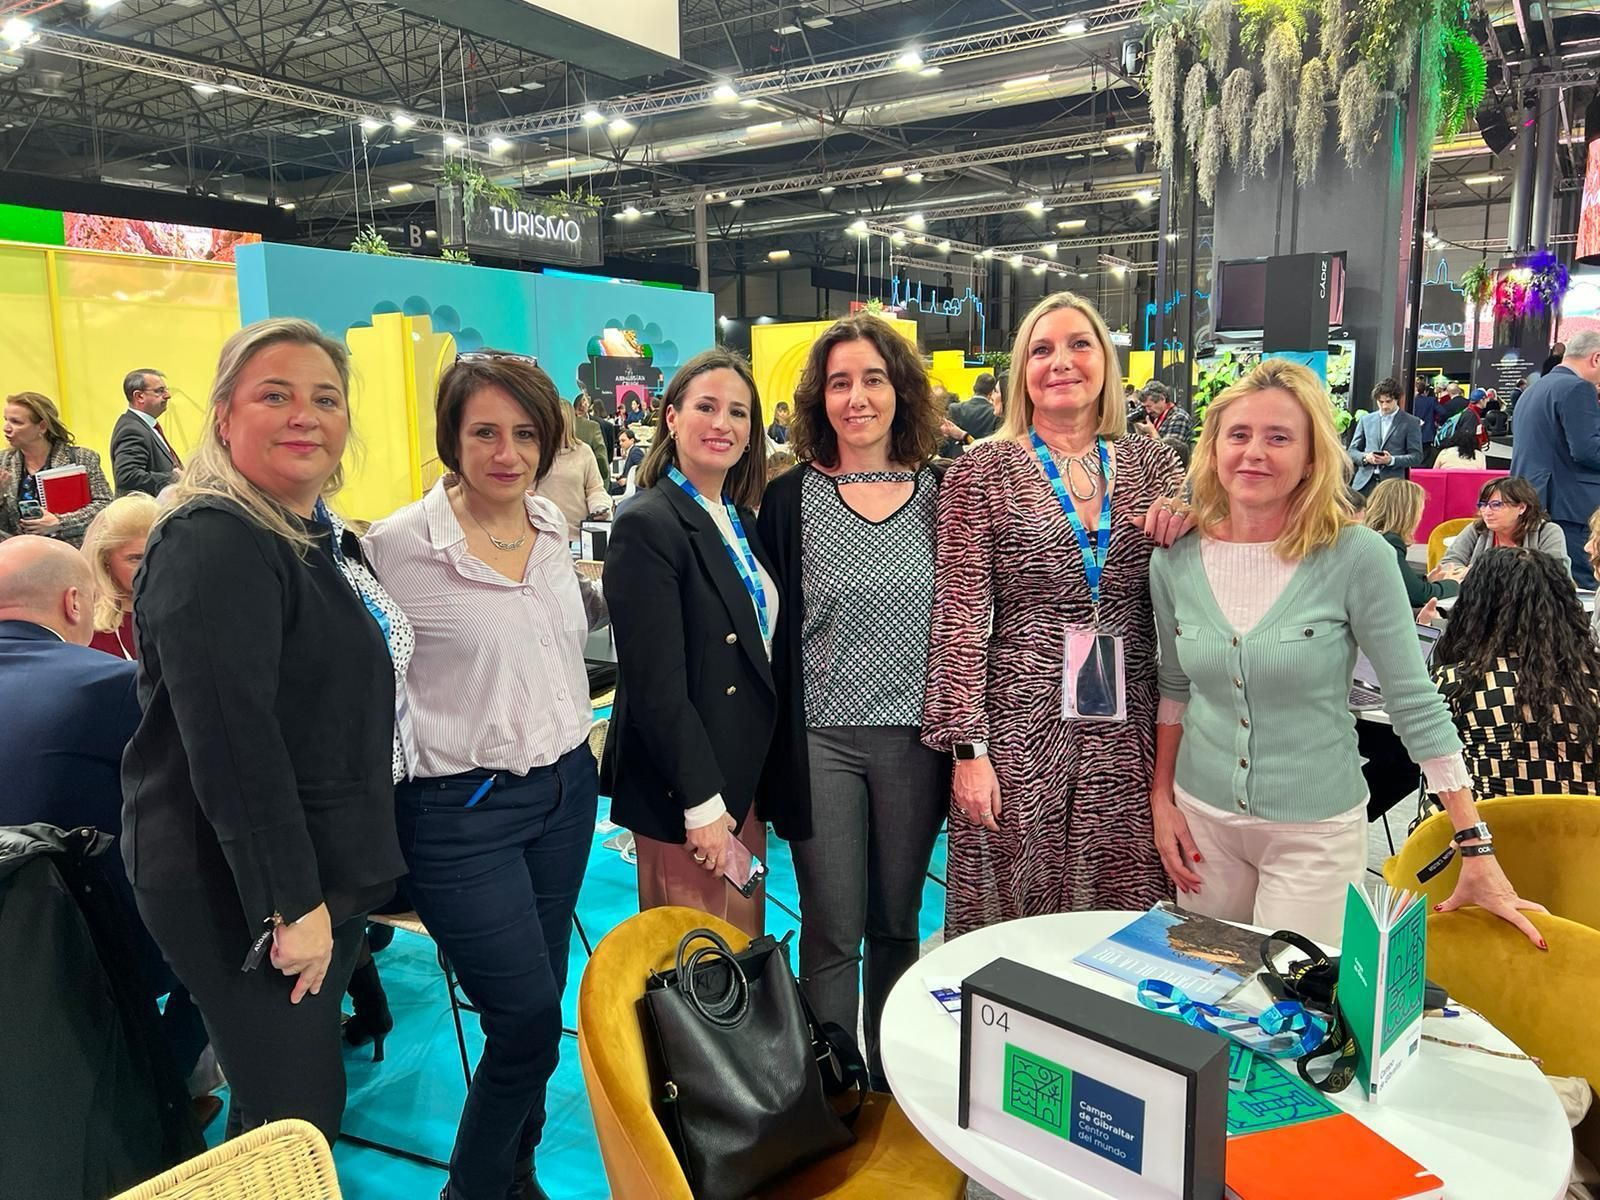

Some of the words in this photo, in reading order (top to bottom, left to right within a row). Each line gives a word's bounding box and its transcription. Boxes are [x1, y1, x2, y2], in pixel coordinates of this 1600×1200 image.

[409, 224, 422, 248] B
[489, 206, 581, 243] TURISMO
[1417, 336, 1452, 349] LAGA
[981, 1003, 1010, 1033] 04
[1080, 1100, 1113, 1121] Campo
[1078, 1120, 1110, 1141] Centro
[1079, 1111, 1091, 1122] de
[1093, 1117, 1135, 1141] Gibraltar
[1078, 1131, 1092, 1143] del
[1094, 1138, 1127, 1159] mundo
